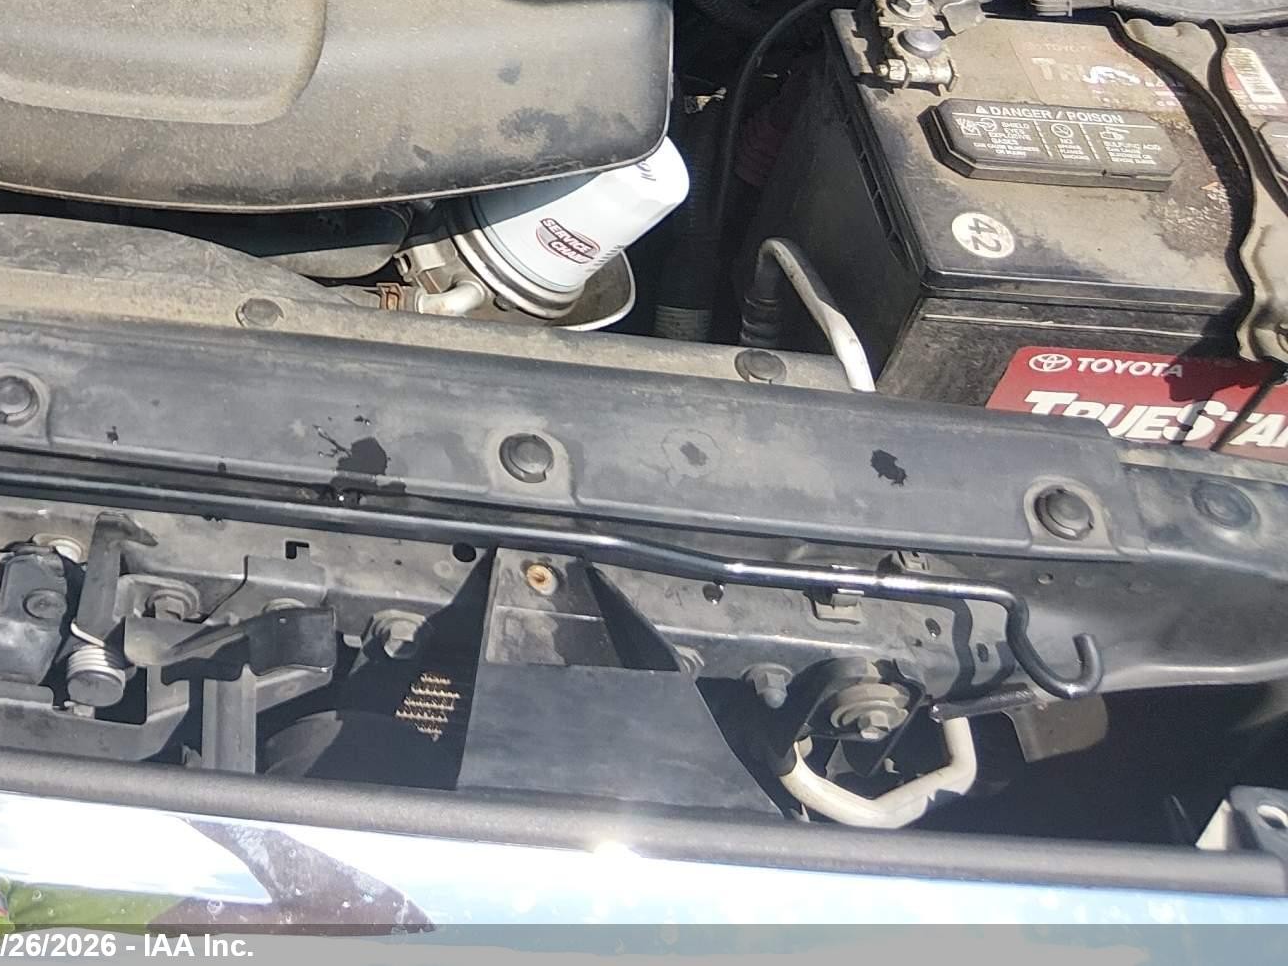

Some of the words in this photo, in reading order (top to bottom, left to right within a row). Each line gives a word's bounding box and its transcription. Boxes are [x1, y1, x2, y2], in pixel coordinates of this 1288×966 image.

[988, 106, 1053, 119] DANGER
[1067, 111, 1124, 124] POISON
[542, 218, 593, 253] SERVICE
[968, 218, 1002, 252] 42
[1077, 357, 1182, 378] TOYOTA
